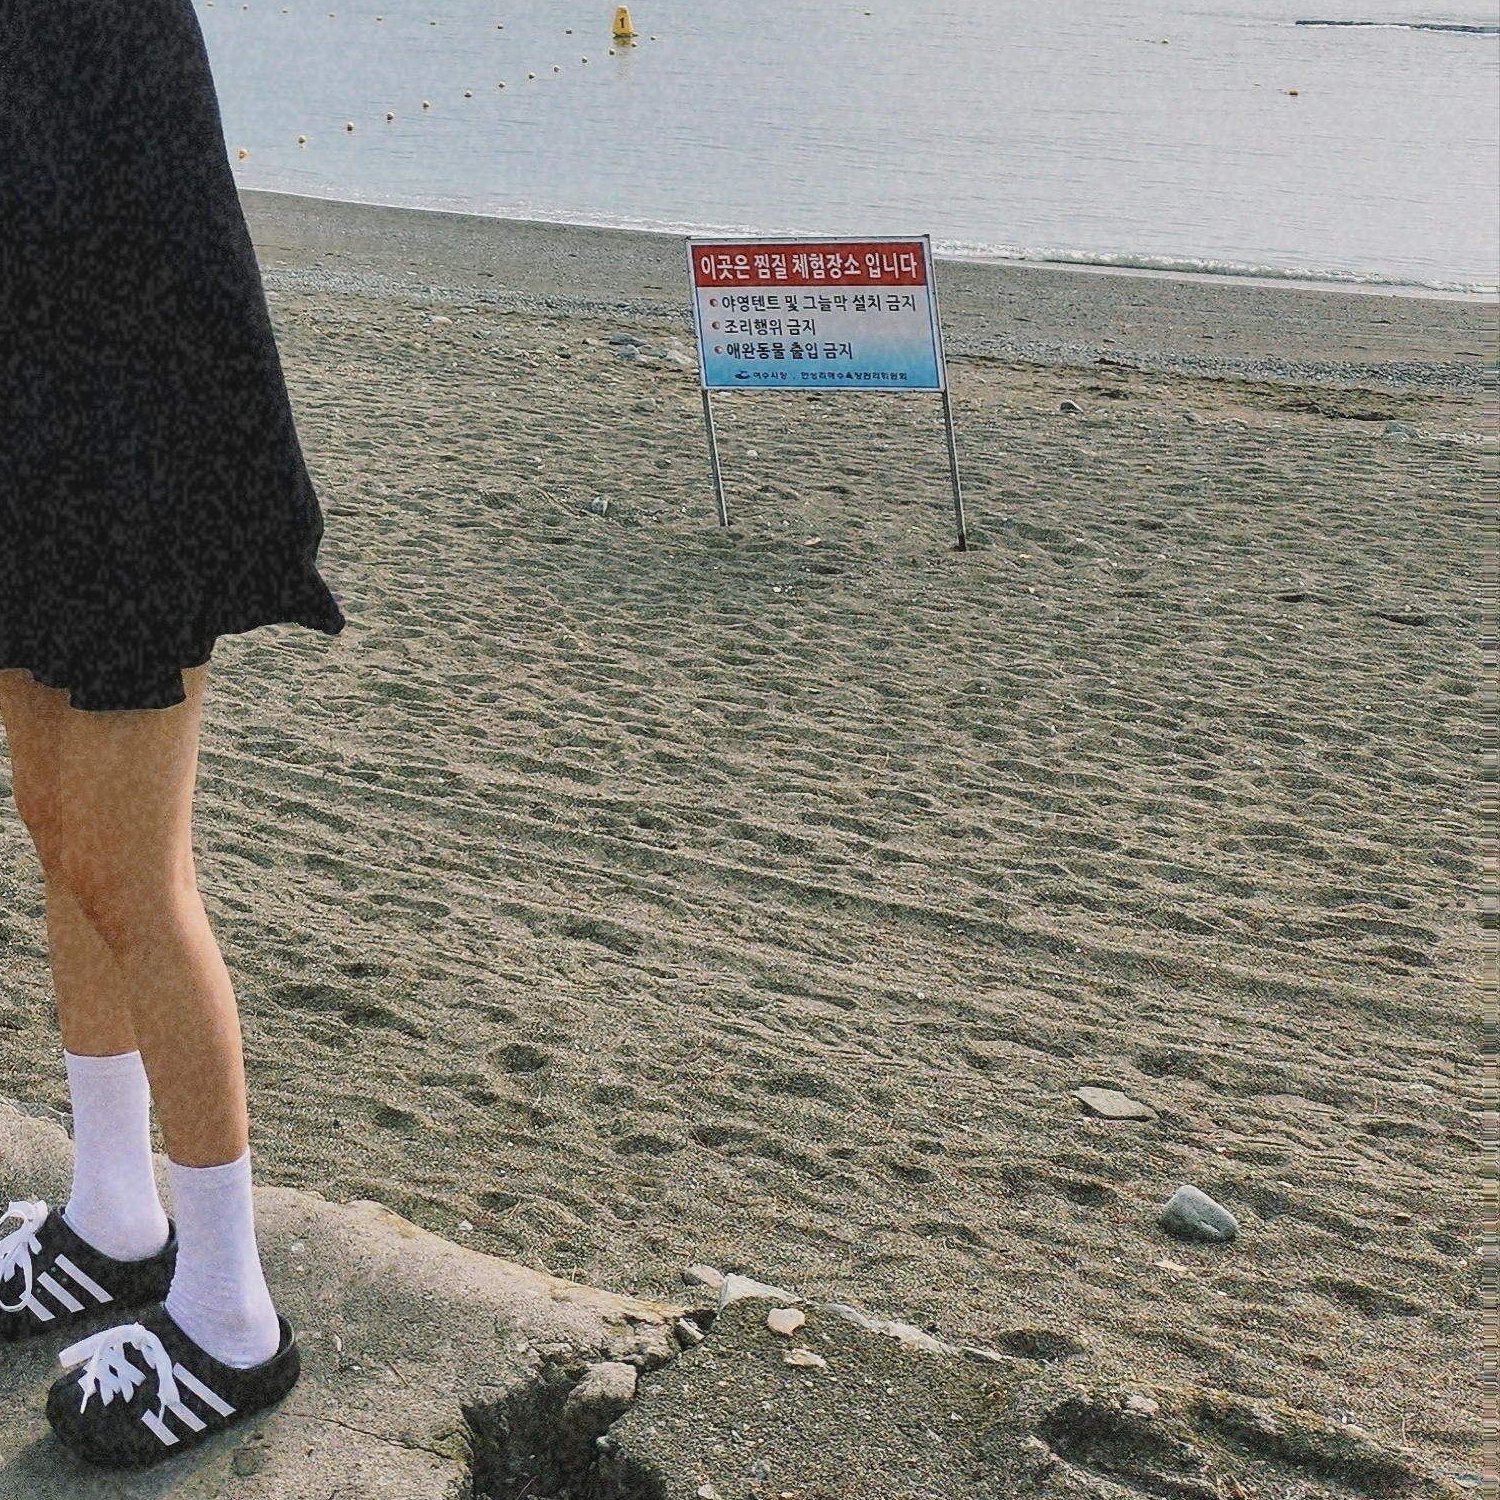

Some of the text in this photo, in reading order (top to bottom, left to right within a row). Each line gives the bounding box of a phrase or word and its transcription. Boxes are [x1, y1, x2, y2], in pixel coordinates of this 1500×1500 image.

[619, 17, 626, 29] 1
[701, 252, 918, 280] 이곳은 찜질 체험장소 입니다
[721, 294, 917, 312] 야영텐트 및 그늘막 설치 금지
[724, 318, 816, 336] 조리행위 금지
[726, 342, 853, 360] 애완동물 출입 금지
